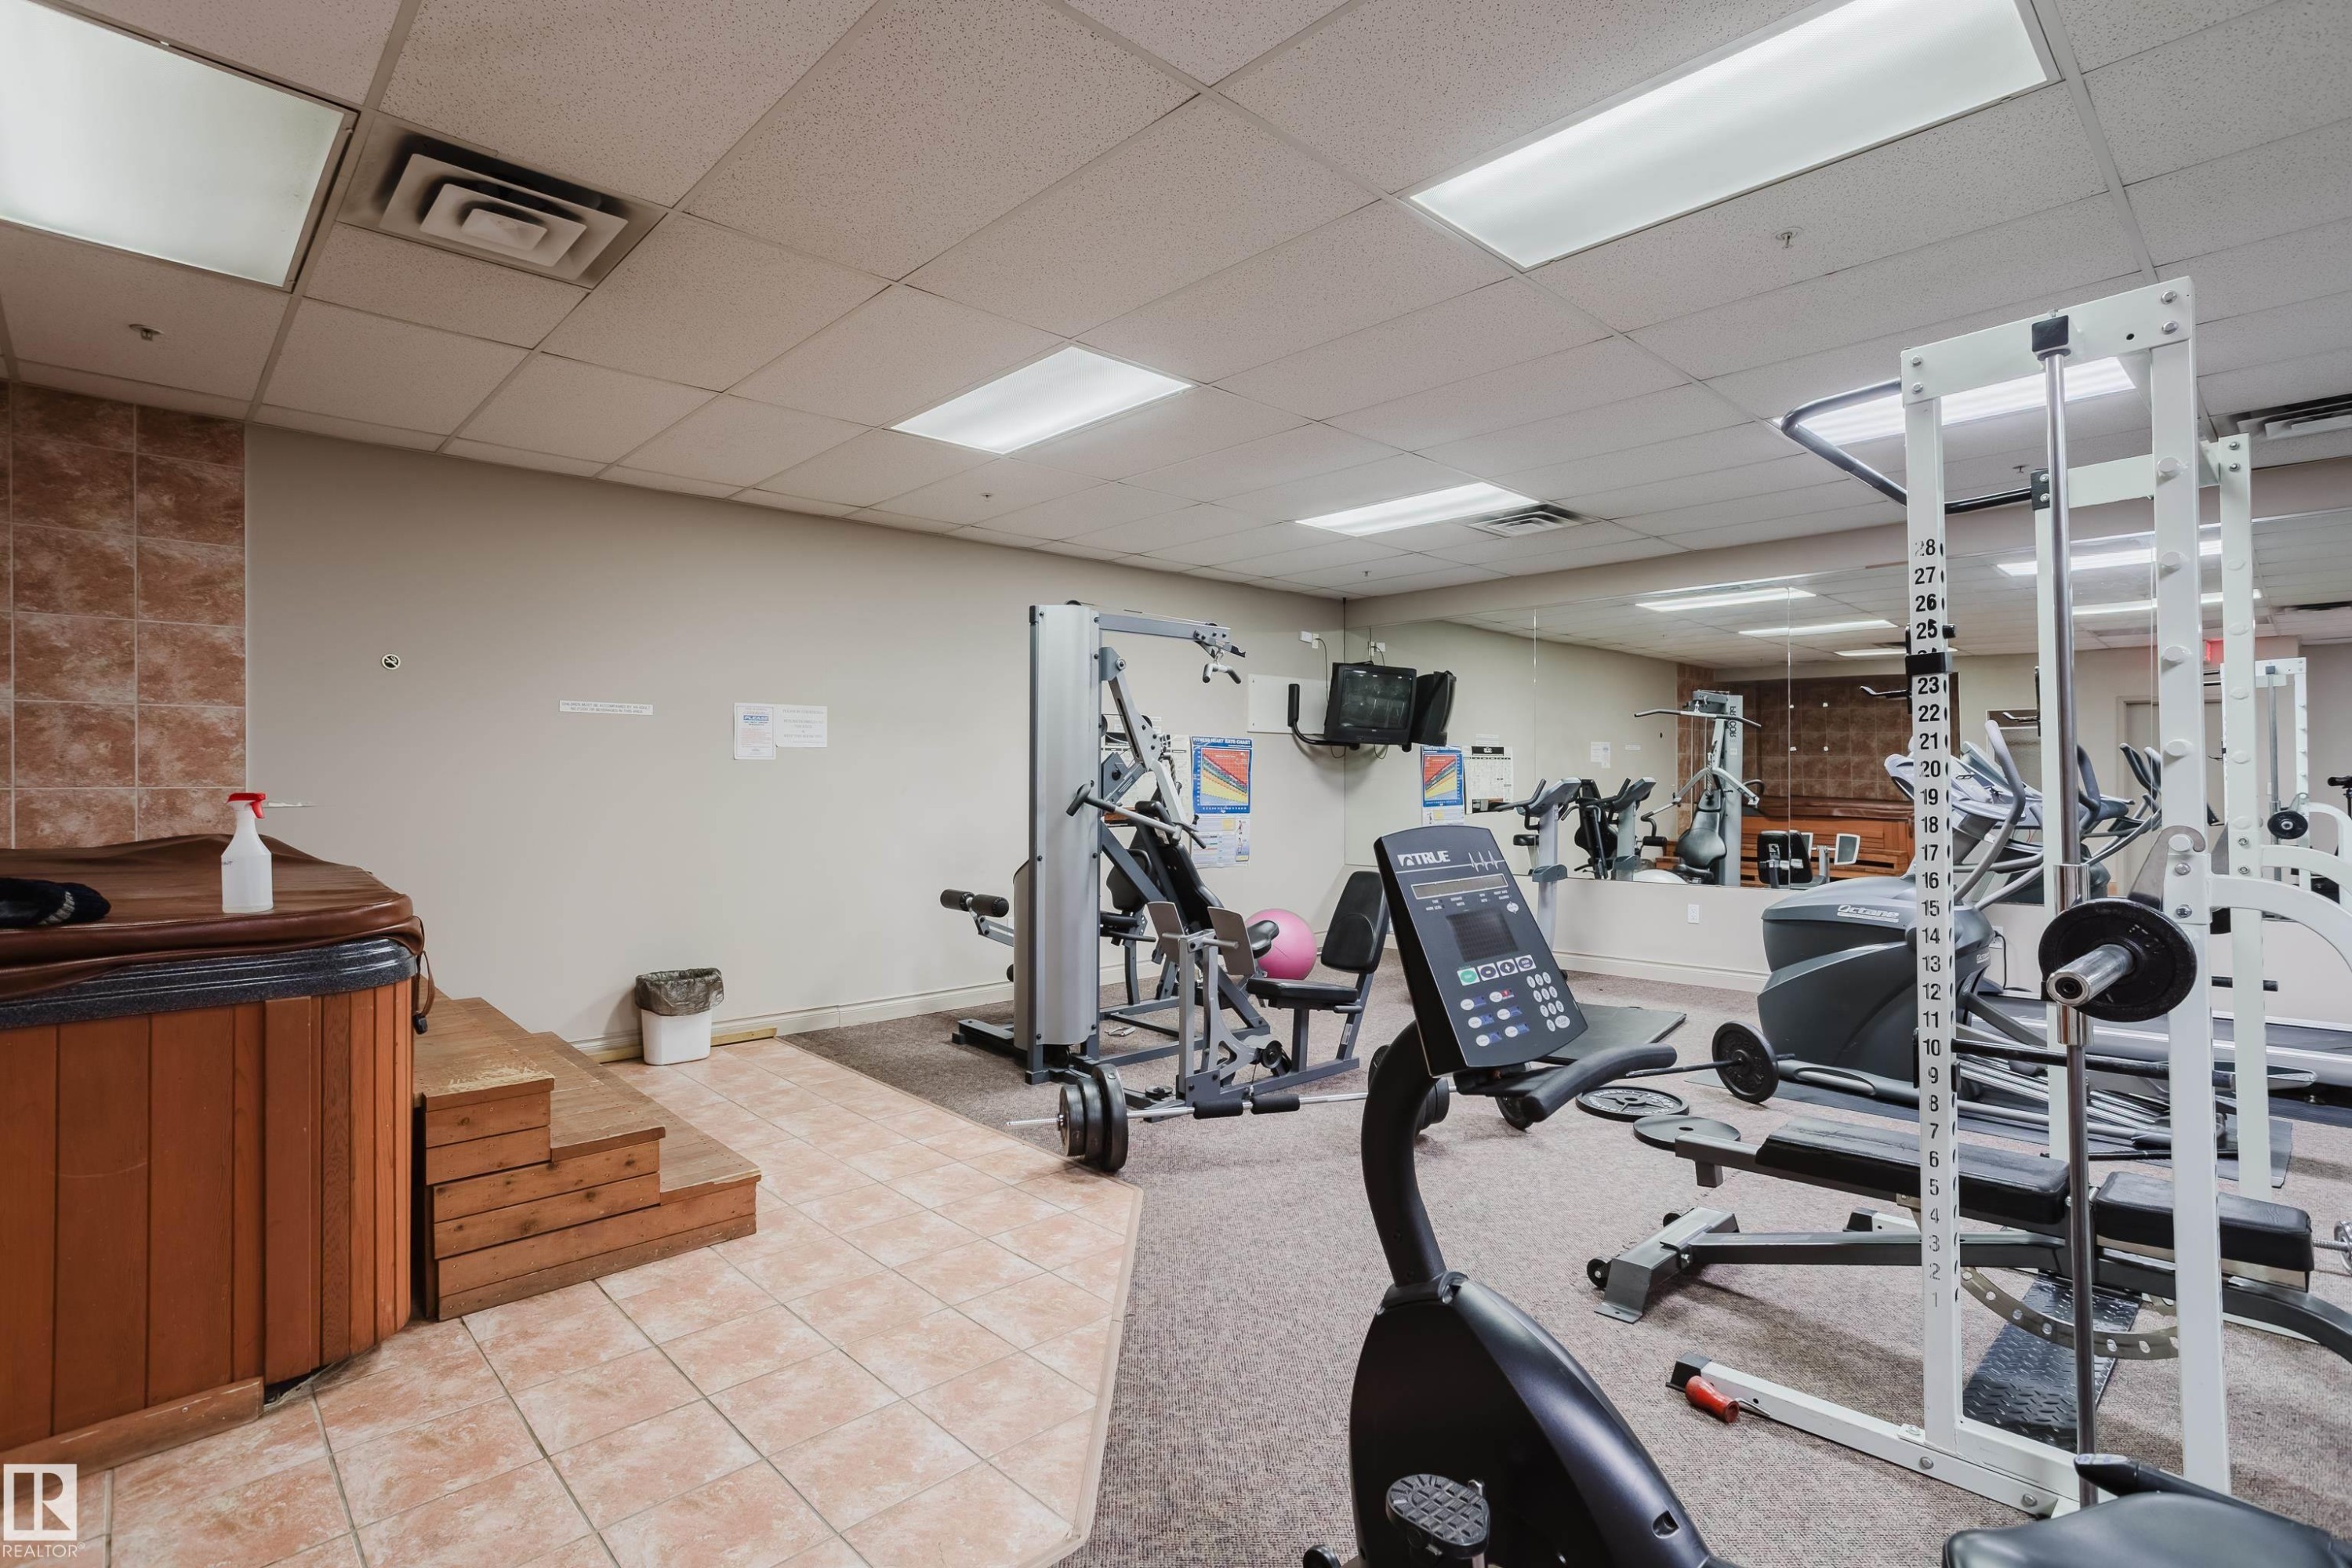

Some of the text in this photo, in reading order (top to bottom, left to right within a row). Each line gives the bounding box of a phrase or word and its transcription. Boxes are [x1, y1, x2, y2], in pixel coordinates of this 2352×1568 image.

[1915, 566, 1936, 585] 27
[1915, 593, 1937, 612] 26
[1916, 619, 1938, 640] 25
[1918, 677, 1940, 695] 23
[1918, 704, 1940, 722] 22
[1919, 732, 1940, 750] 21
[1919, 760, 1940, 778] 20
[1920, 788, 1939, 806] 19
[1921, 816, 1939, 833] 18
[1412, 850, 1451, 866] TRUE
[1921, 844, 1939, 862] 17
[1922, 872, 1939, 889] 16
[1838, 904, 1899, 918] Octane
[1922, 899, 1940, 916] 15
[1922, 927, 1940, 944] 14
[1922, 955, 1940, 973] 13
[1922, 982, 1941, 1000] 12
[1923, 1011, 1940, 1028] 11
[1922, 1039, 1941, 1056] 10
[1929, 1066, 1939, 1084] 9
[1929, 1094, 1939, 1112] 8
[1929, 1123, 1939, 1139] 7
[1929, 1150, 1939, 1167] 6
[1929, 1178, 1940, 1196] 5
[1930, 1207, 1940, 1225] 4
[1929, 1235, 1940, 1252] 3
[1929, 1262, 1940, 1280] 2
[1932, 1291, 1938, 1308] 1
